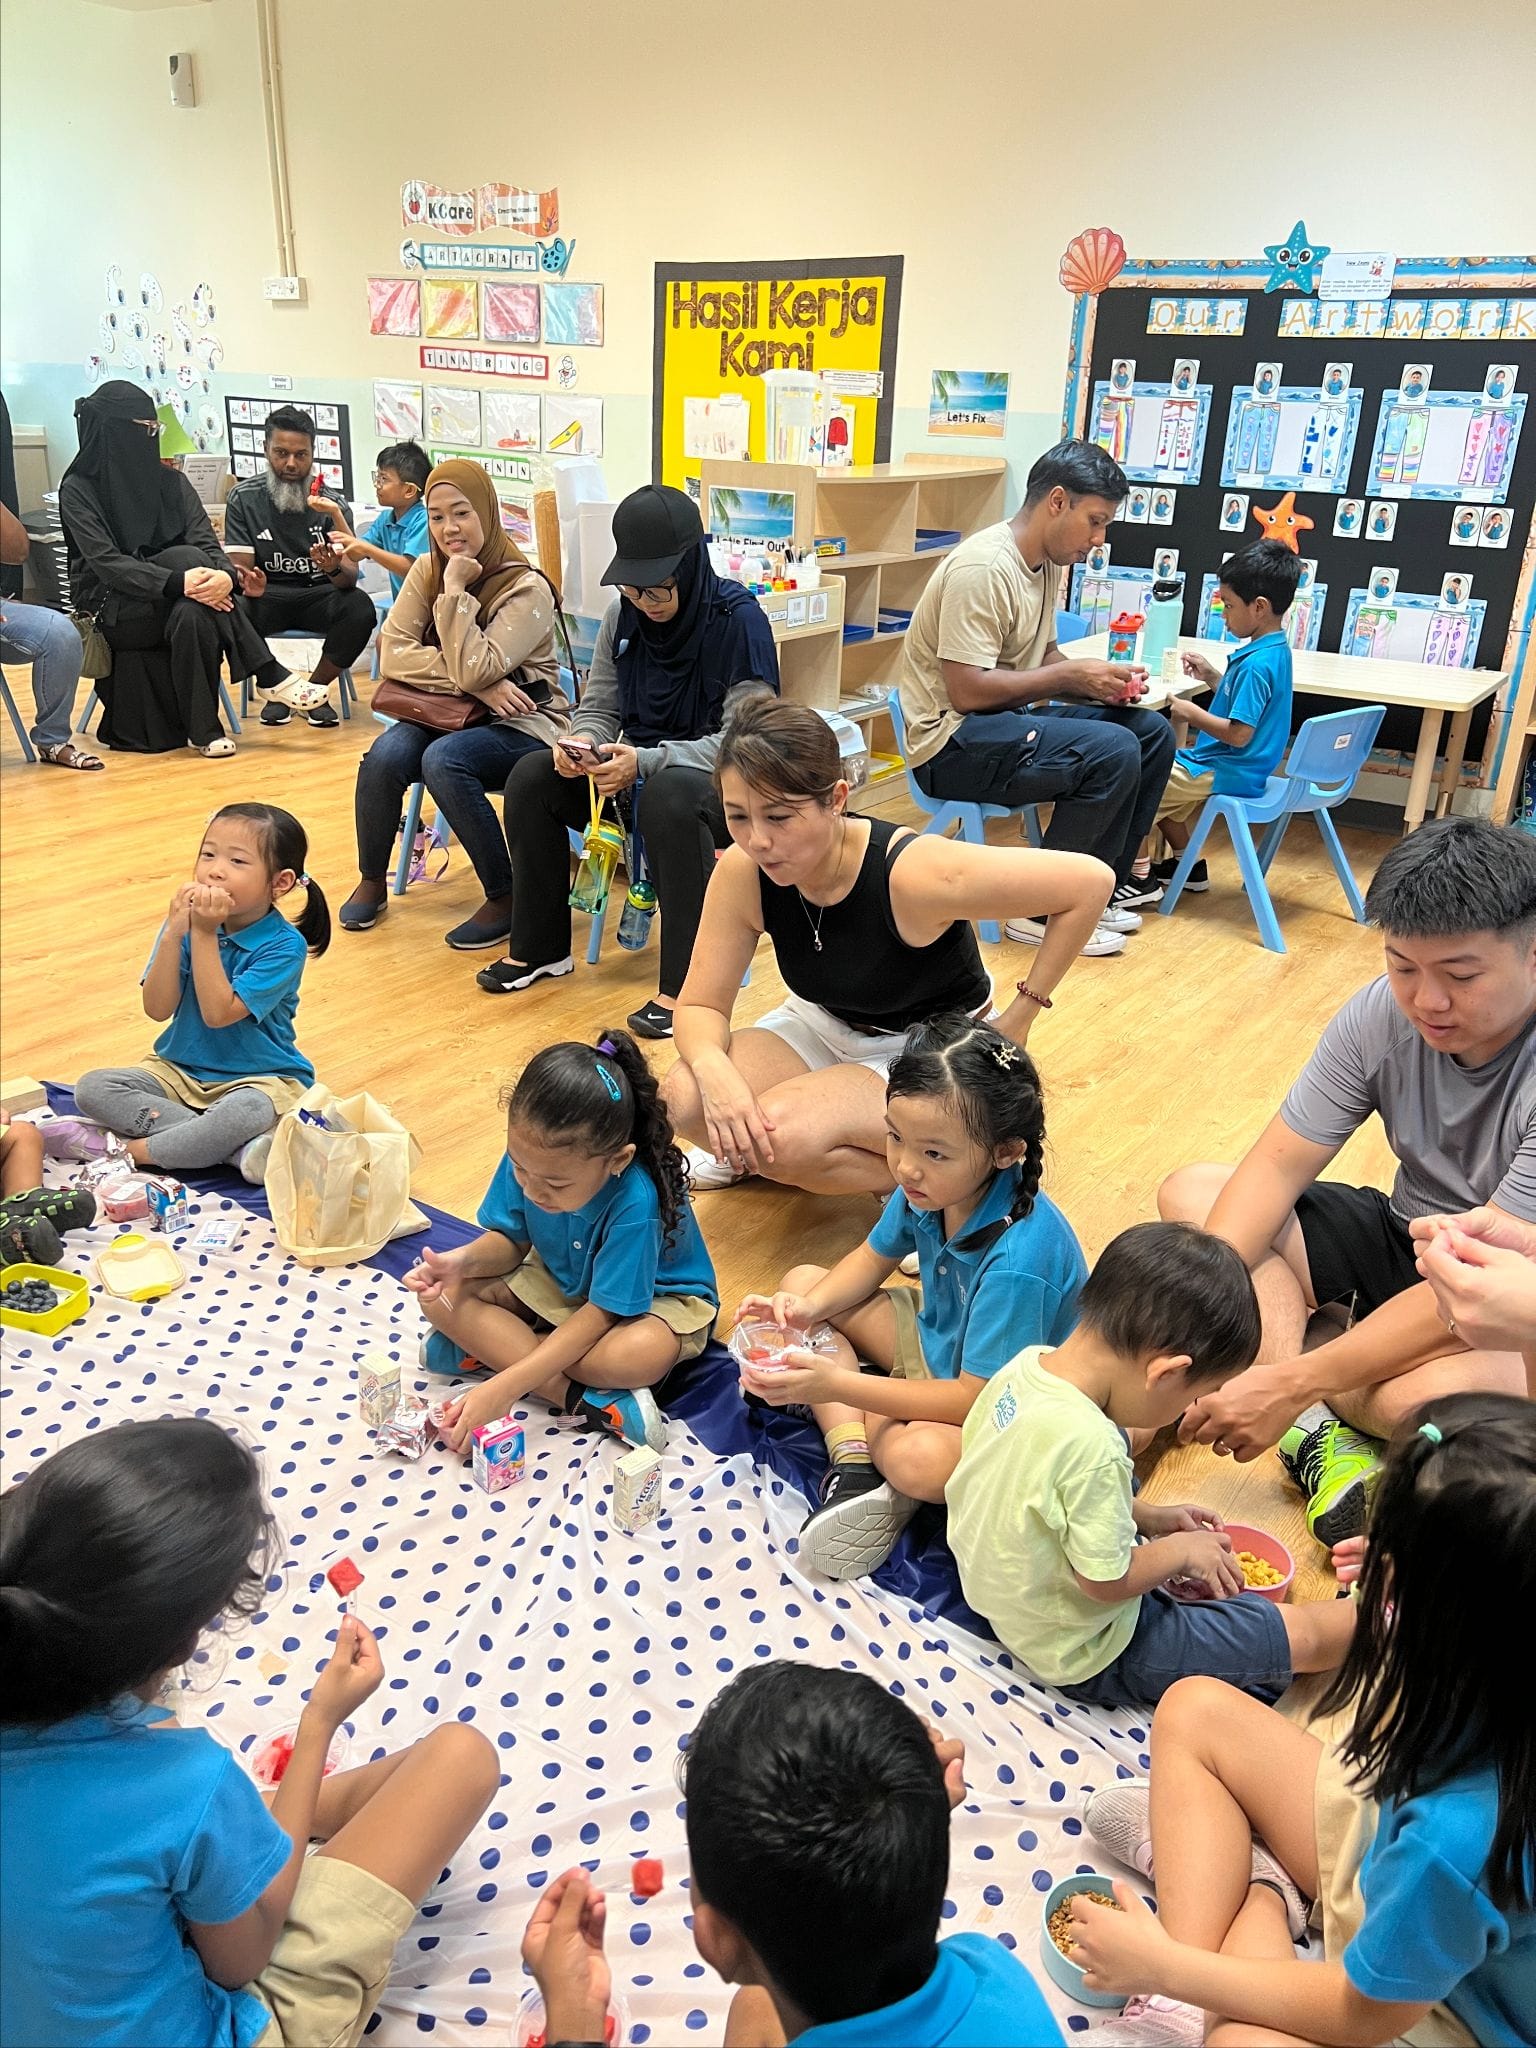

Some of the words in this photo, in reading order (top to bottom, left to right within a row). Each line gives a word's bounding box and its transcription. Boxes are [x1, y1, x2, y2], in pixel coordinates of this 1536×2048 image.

[428, 203, 473, 219] KCare
[672, 281, 758, 329] Hasil
[769, 279, 877, 338] Kerja
[1155, 302, 1235, 328] Our
[1286, 302, 1535, 333] Artwork
[720, 331, 814, 377] Kami
[947, 411, 970, 423] Let's
[972, 413, 986, 423] Fix
[438, 458, 526, 475] GENIN
[767, 541, 785, 553] Out
